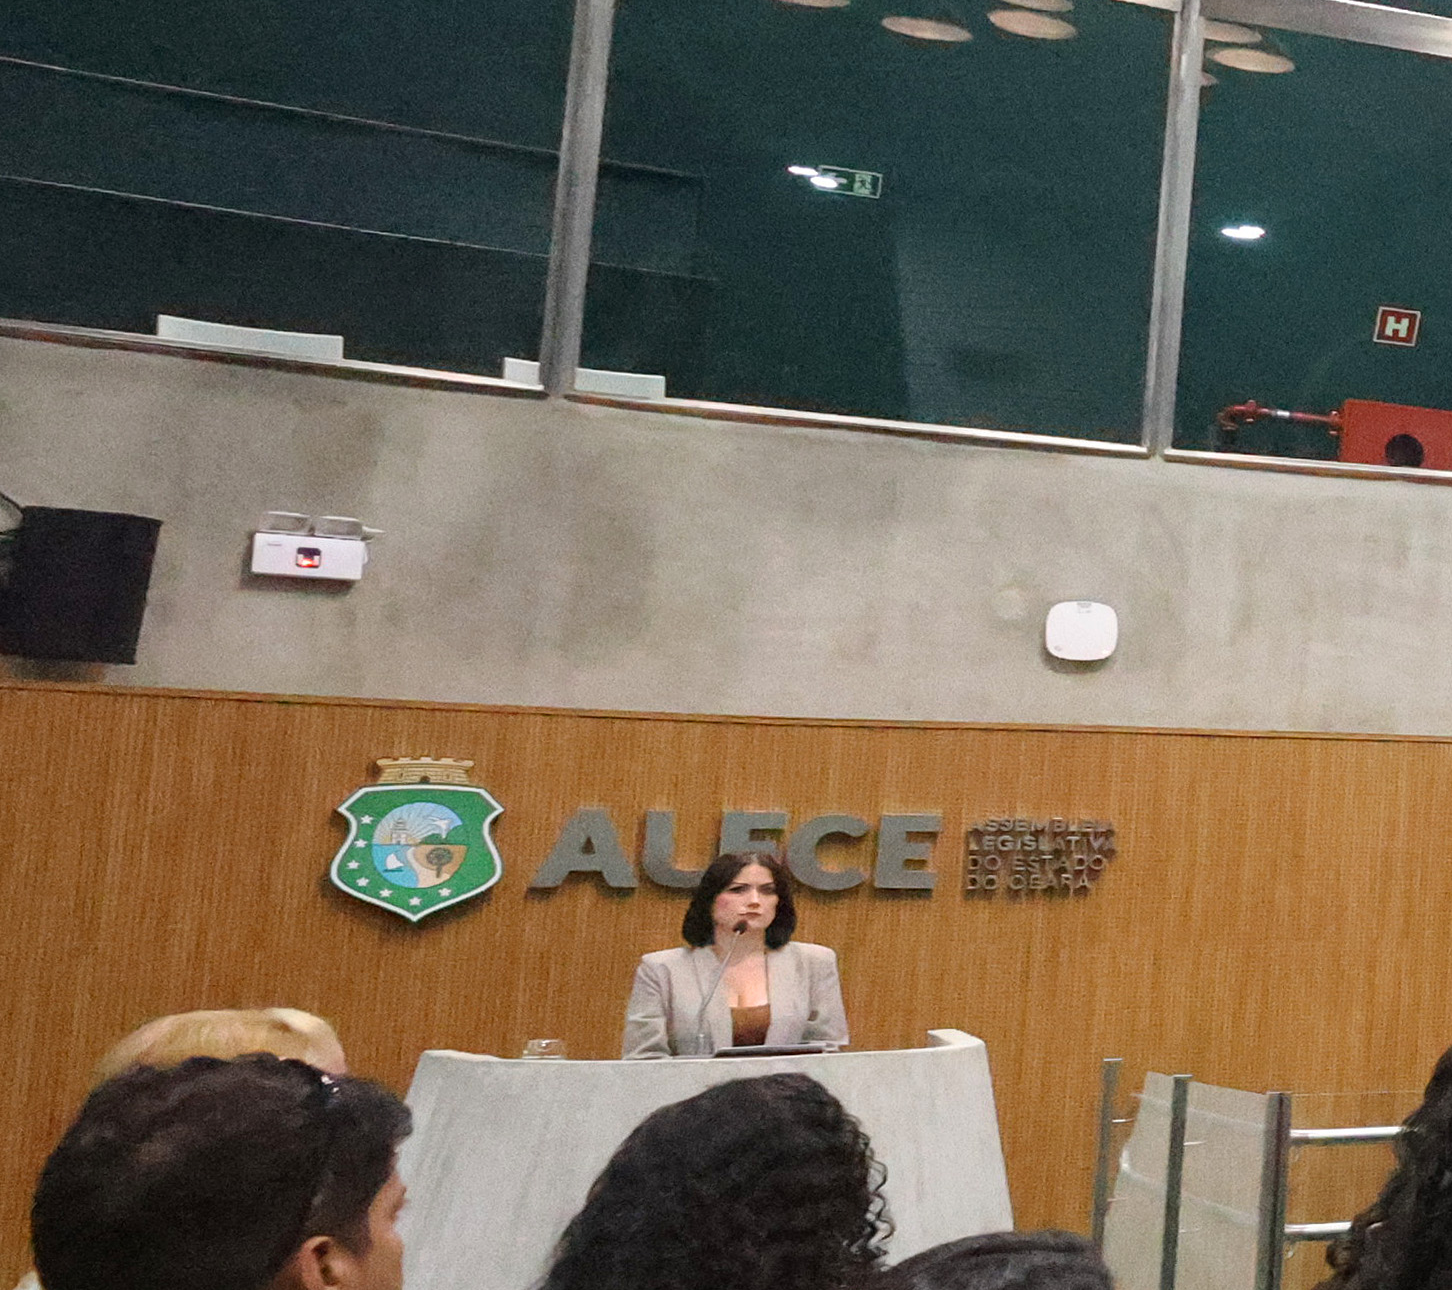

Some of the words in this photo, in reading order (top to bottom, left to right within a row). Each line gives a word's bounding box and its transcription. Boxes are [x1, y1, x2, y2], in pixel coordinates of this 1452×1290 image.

[1384, 315, 1410, 338] H
[968, 855, 1000, 870] DO
[1013, 854, 1105, 871] ESTADO
[967, 874, 999, 889] DO
